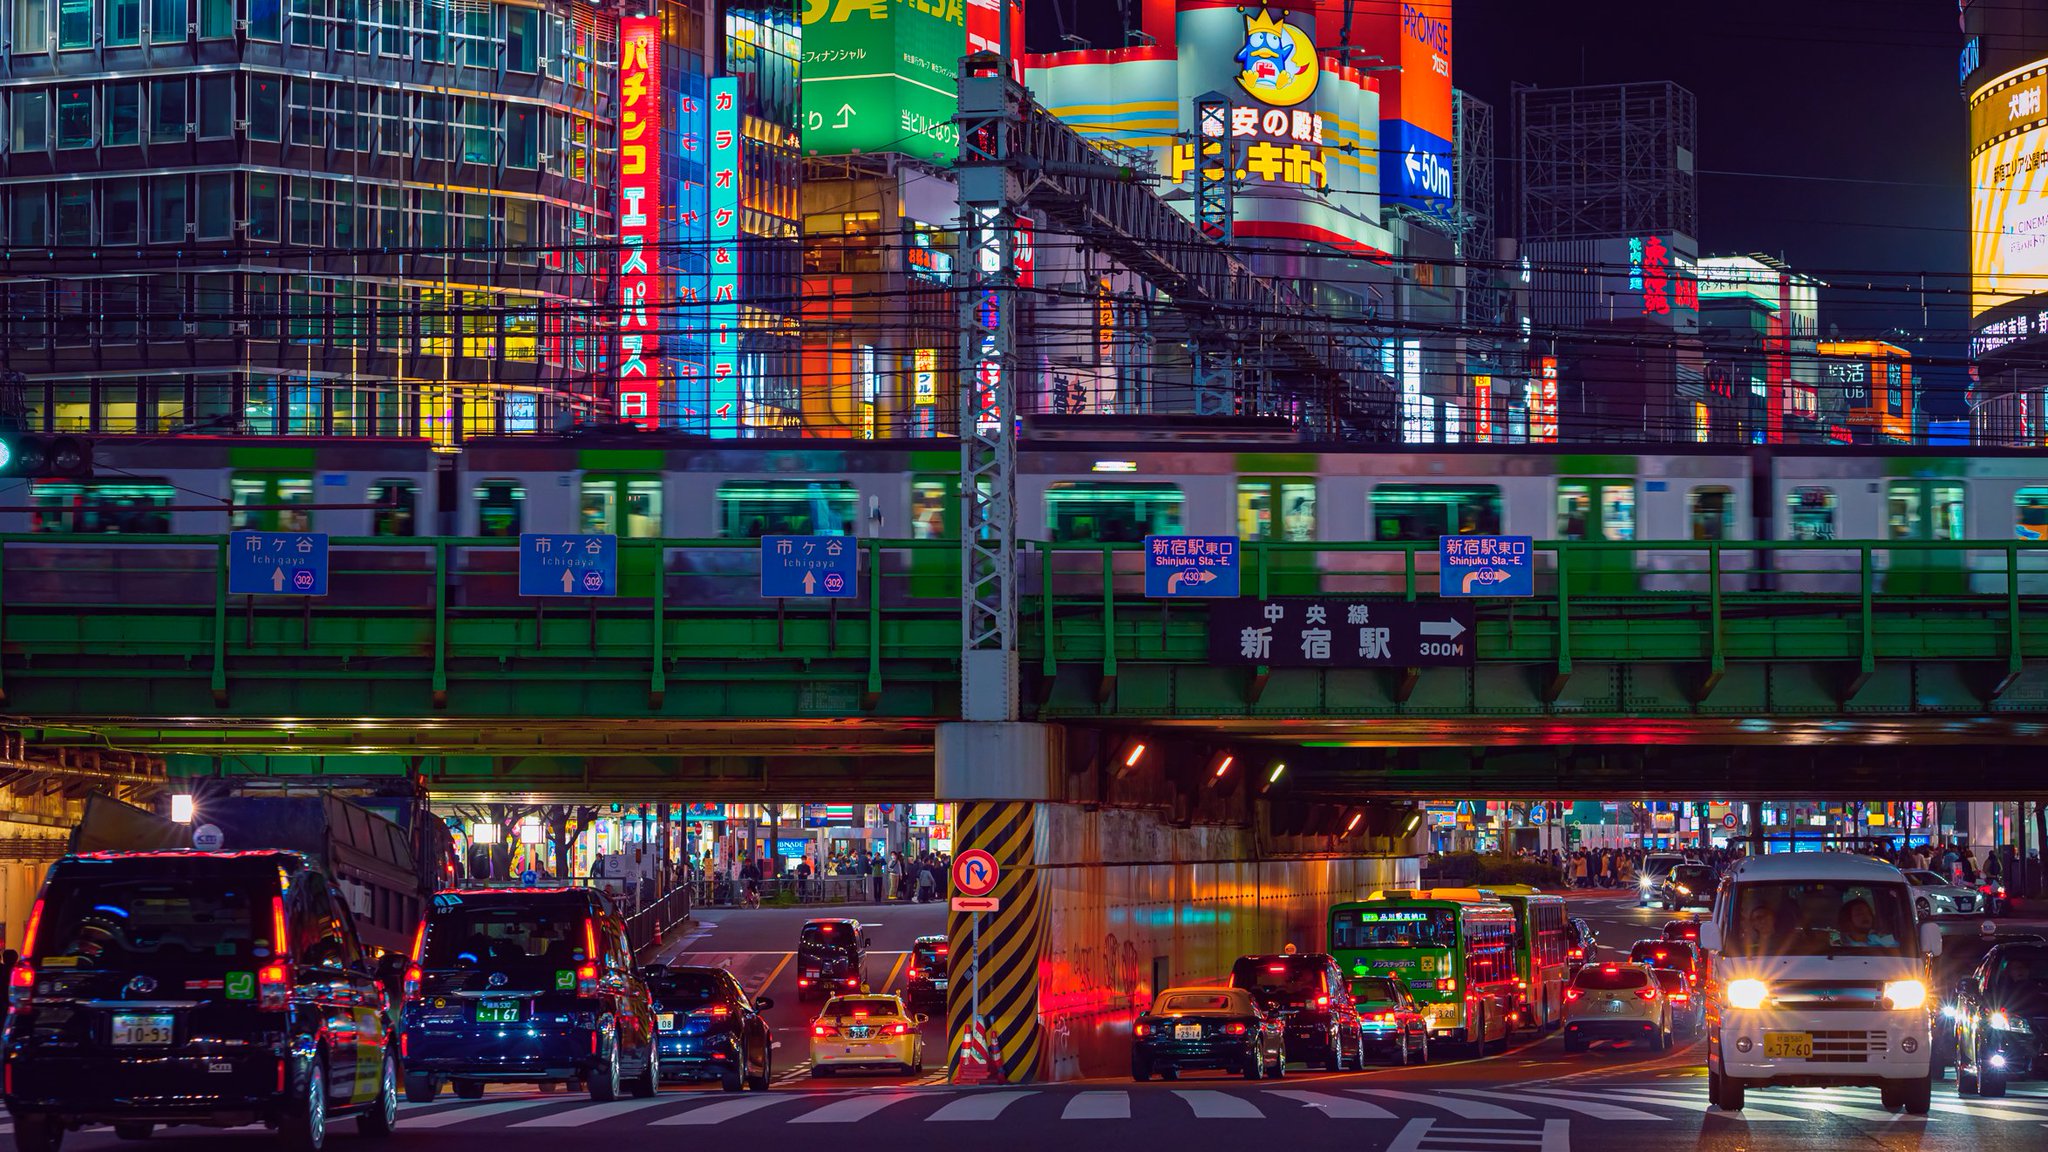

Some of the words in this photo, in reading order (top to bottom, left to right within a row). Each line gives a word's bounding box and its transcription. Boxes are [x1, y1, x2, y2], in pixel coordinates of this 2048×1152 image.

[1403, 3, 1448, 55] PROMISE
[620, 36, 649, 426] パチンコエスパス日
[1543, 365, 1558, 437] カラオケ
[1152, 538, 1233, 555] 新宿駅東口
[1446, 538, 1525, 555] 新宿駅東口
[253, 555, 305, 567] Ichigaya
[543, 557, 594, 568] Ichigaya
[784, 558, 835, 569] Ichigaya
[1156, 556, 1195, 567] Shinjuku
[1449, 556, 1489, 566] Shinjuku
[296, 575, 311, 586] 302
[586, 577, 600, 587] 302
[1184, 572, 1199, 582] 430
[1478, 571, 1493, 582] 430
[827, 578, 841, 588] 302
[1264, 604, 1369, 625] 中央線
[1240, 627, 1391, 660] 新宿駅
[1420, 643, 1464, 657] 300M
[127, 1027, 170, 1042] 10-93
[1775, 1043, 1811, 1056] 37-60
